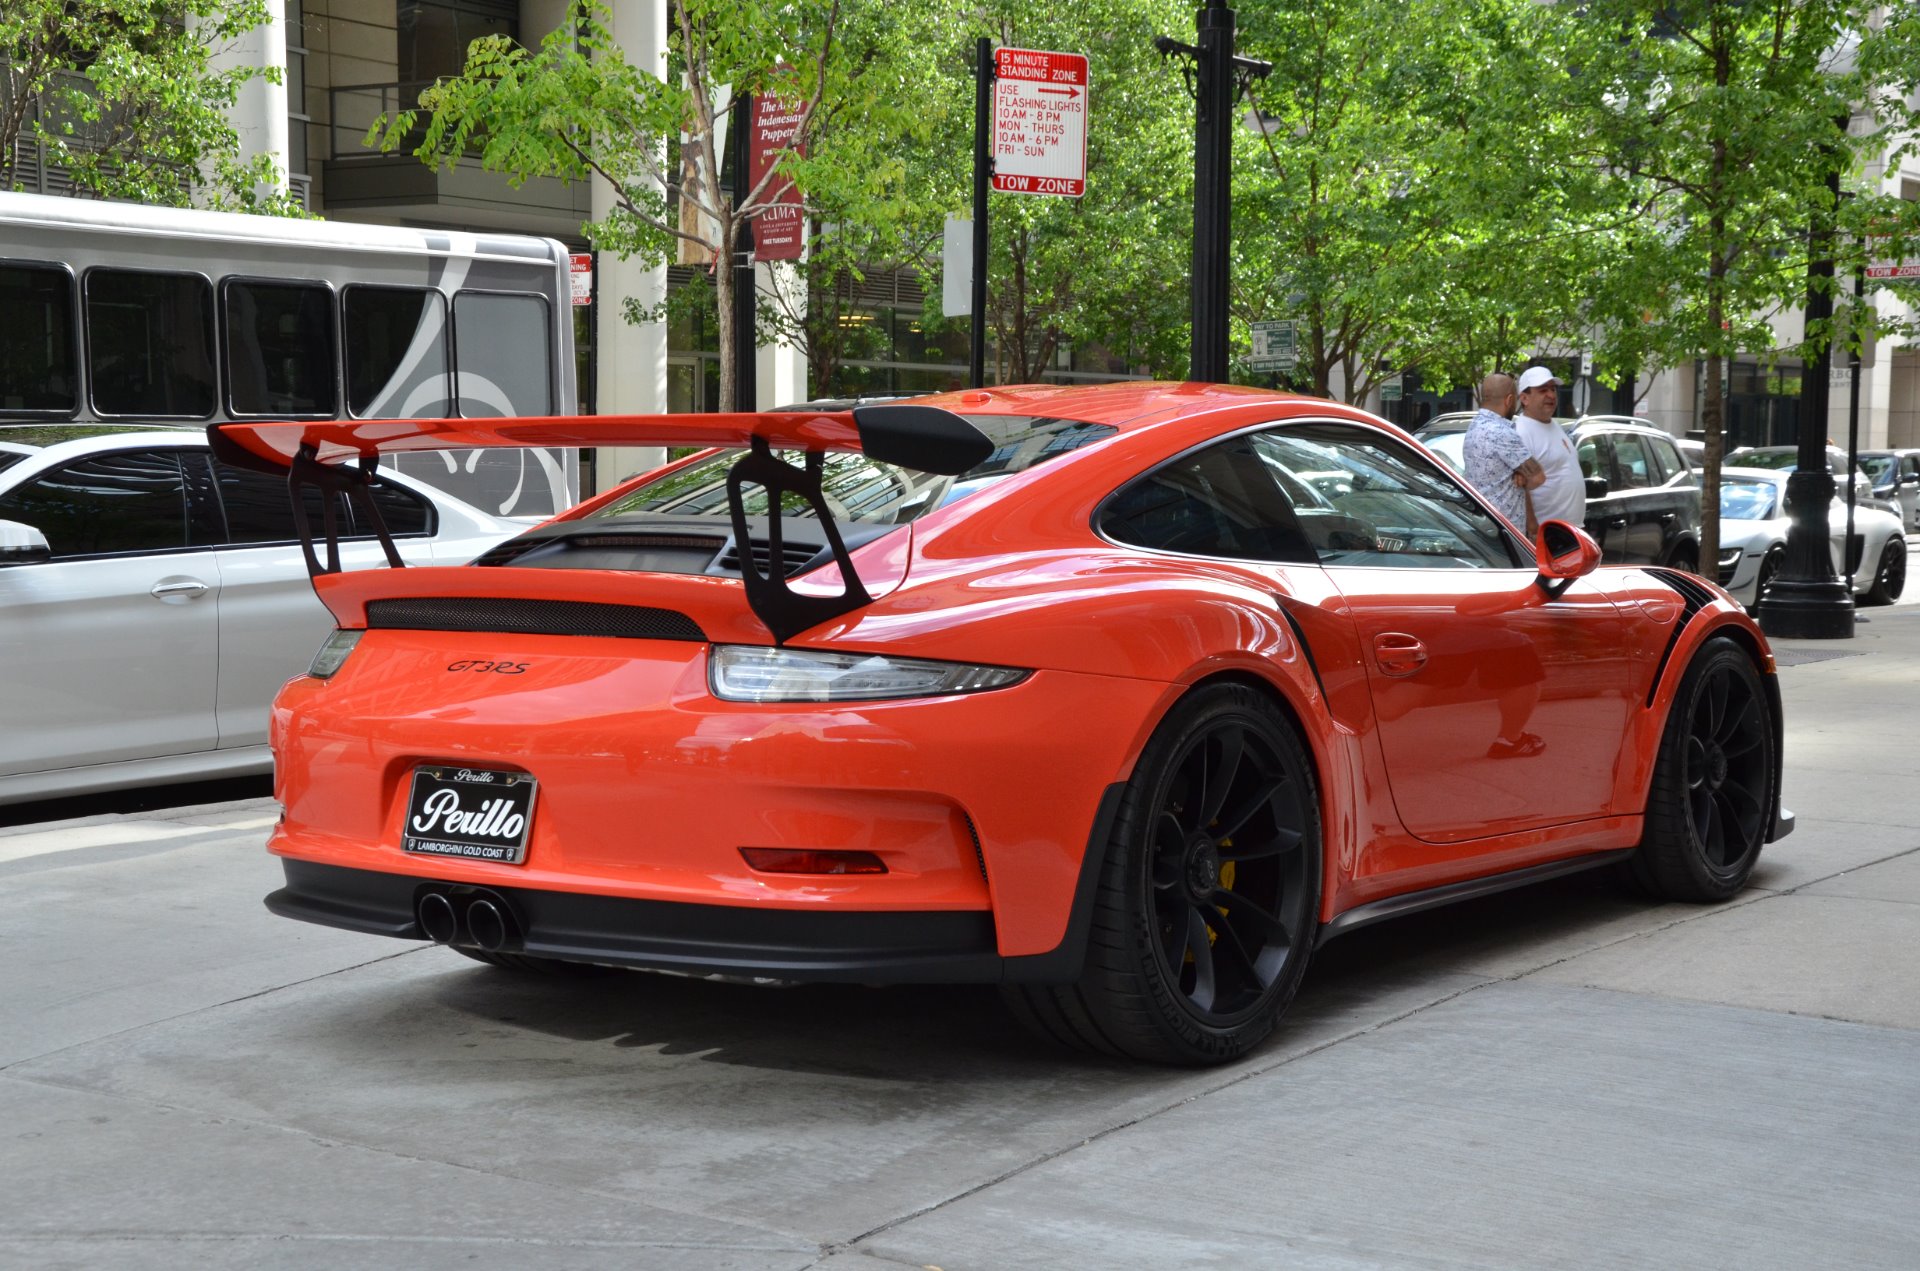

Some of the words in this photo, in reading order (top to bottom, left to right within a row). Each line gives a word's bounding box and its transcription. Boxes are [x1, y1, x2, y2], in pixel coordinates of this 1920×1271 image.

[1000, 52, 1010, 63] 15
[1014, 54, 1049, 66] MINUTE
[1000, 65, 1047, 78] STANDING
[1052, 70, 1077, 81] ZONE
[1000, 84, 1019, 95] USE
[761, 101, 776, 113] The
[999, 96, 1046, 110] FLASHING
[1049, 101, 1081, 113] LIGHTS
[1037, 111, 1043, 121] 8
[1046, 112, 1060, 122] PM
[999, 120, 1021, 131] MON
[1032, 122, 1064, 135] THURS
[761, 128, 795, 142] Puppetr
[1036, 135, 1042, 145] 6
[1045, 136, 1059, 146] PM
[998, 144, 1014, 155] FRI
[1024, 146, 1044, 156] SUN
[998, 176, 1029, 190] TOW
[1037, 178, 1076, 193] ZONE
[763, 206, 796, 221] LUMA
[454, 769, 494, 782] Perillo
[413, 789, 524, 838] Perillo
[417, 841, 462, 854] LAMBORGHINI
[463, 846, 481, 855] GOLD
[482, 848, 503, 858] COAST
